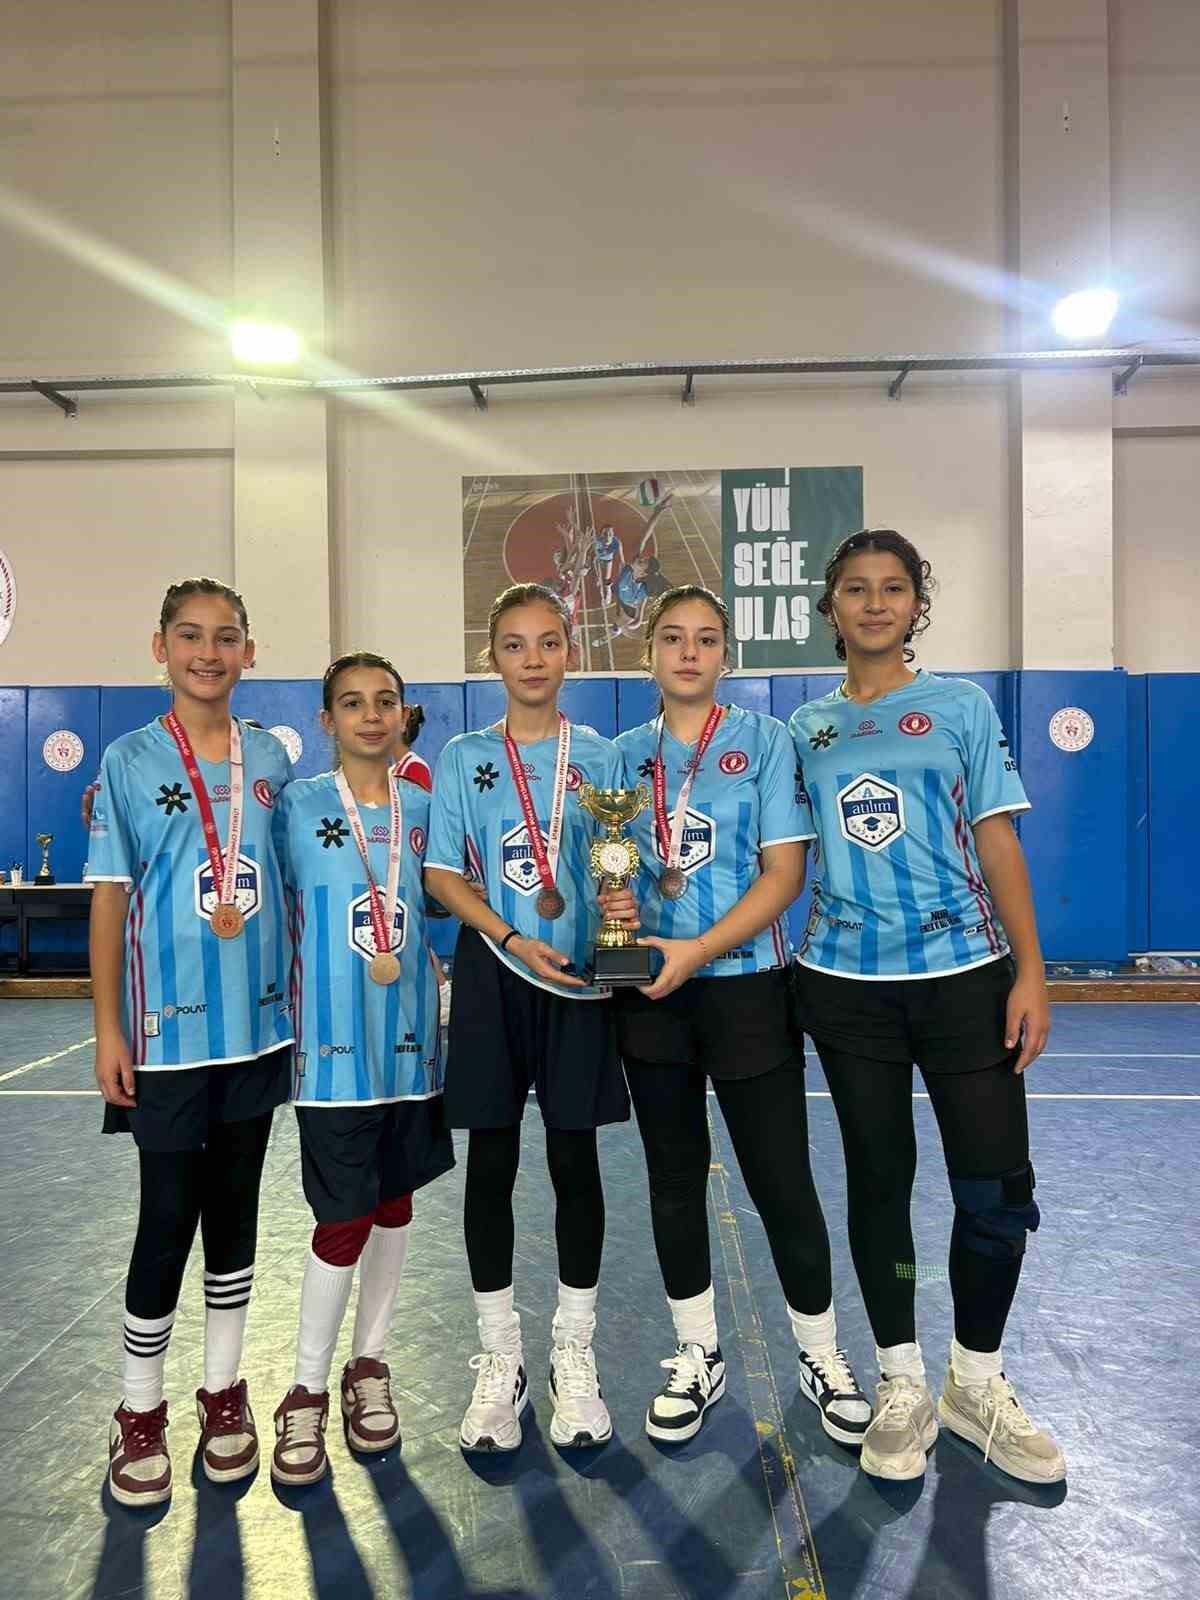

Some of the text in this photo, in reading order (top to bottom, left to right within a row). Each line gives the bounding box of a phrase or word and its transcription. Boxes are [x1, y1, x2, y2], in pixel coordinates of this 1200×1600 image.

[733, 482, 790, 532] YÜK
[734, 595, 810, 645] ULAŞ
[852, 799, 892, 815] atılım
[175, 1003, 208, 1015] POLAT
